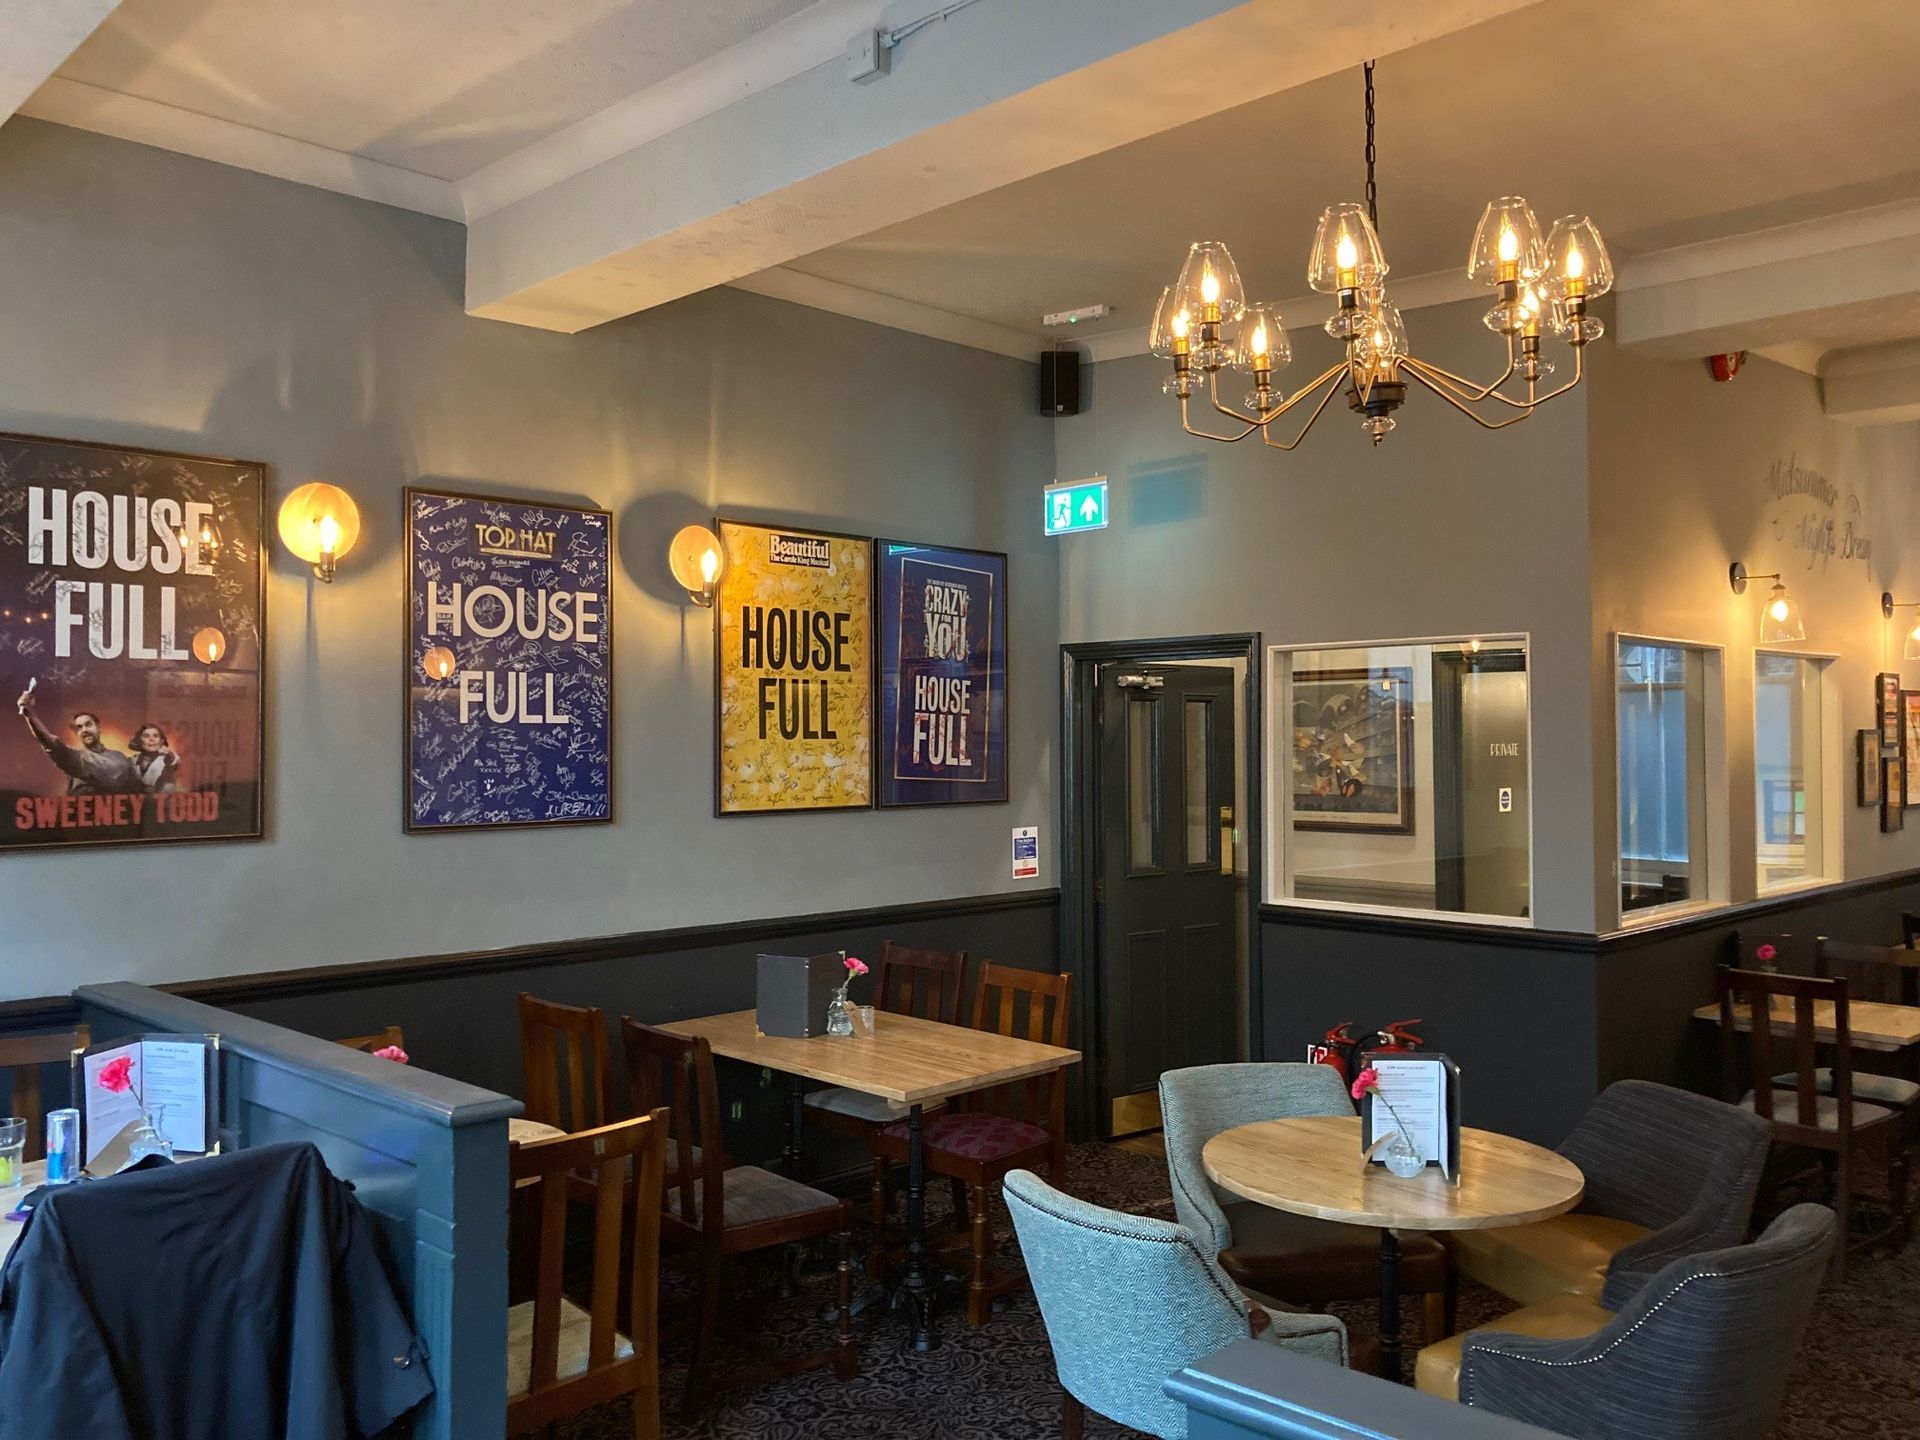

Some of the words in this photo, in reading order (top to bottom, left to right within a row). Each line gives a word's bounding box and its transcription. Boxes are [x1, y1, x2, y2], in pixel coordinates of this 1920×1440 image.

[28, 486, 214, 576] HOUSE
[475, 523, 516, 549] TOP
[520, 528, 556, 552] HAT
[770, 535, 830, 559] Beautiful
[55, 580, 189, 661] FULL
[428, 581, 598, 643] HOUSE
[925, 585, 968, 617] CRAZY
[742, 605, 851, 672] HOUSE
[927, 613, 967, 661] YOU
[459, 670, 570, 724] FULL
[758, 677, 837, 740] FULL
[914, 675, 971, 715] HOUSE
[912, 712, 972, 767] FULL
[1490, 743, 1519, 756] PRIVATE
[15, 793, 146, 830] SWEENEY
[153, 791, 220, 824] TODD
